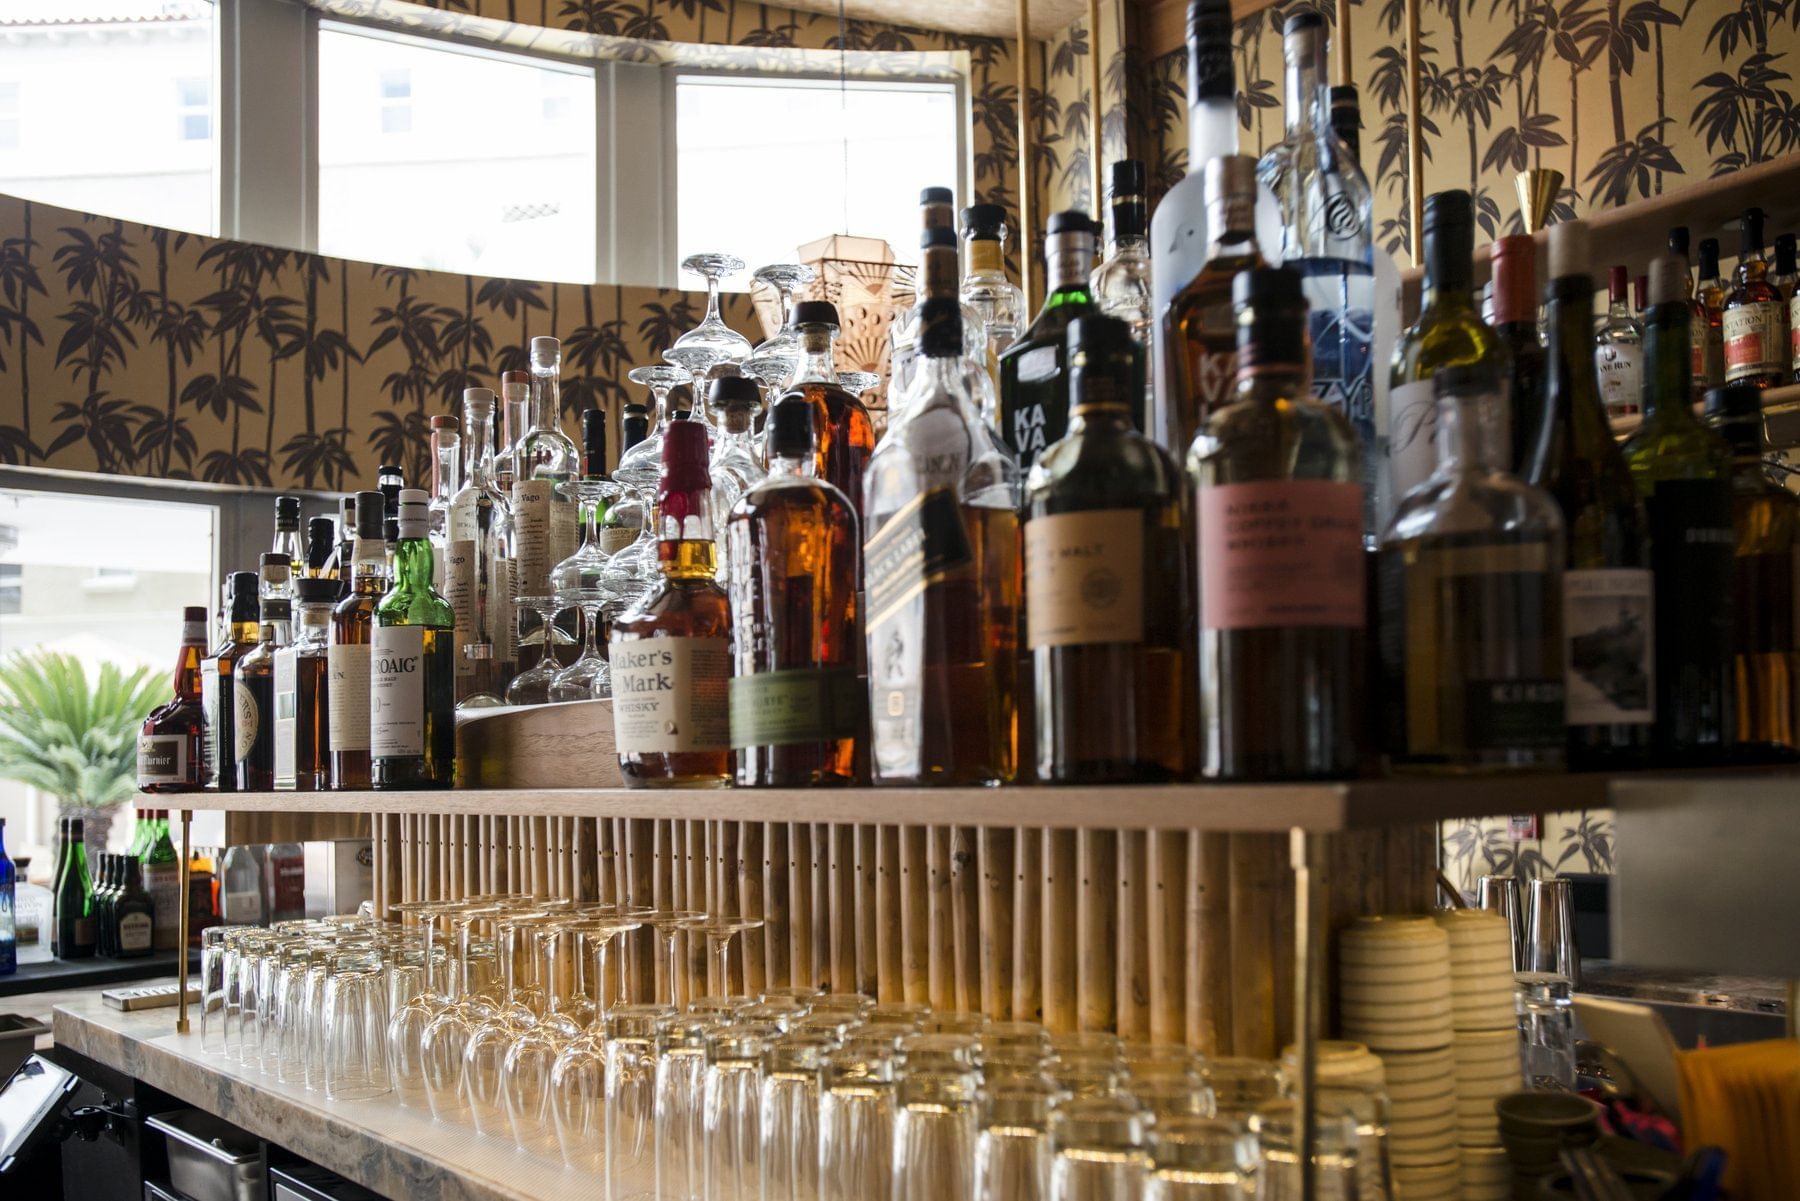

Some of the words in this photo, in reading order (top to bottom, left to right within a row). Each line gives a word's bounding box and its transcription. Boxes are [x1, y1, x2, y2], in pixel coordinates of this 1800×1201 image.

[1014, 403, 1047, 430] KA
[1015, 426, 1047, 453] VA
[521, 494, 540, 503] Vago
[622, 673, 673, 694] Mark
